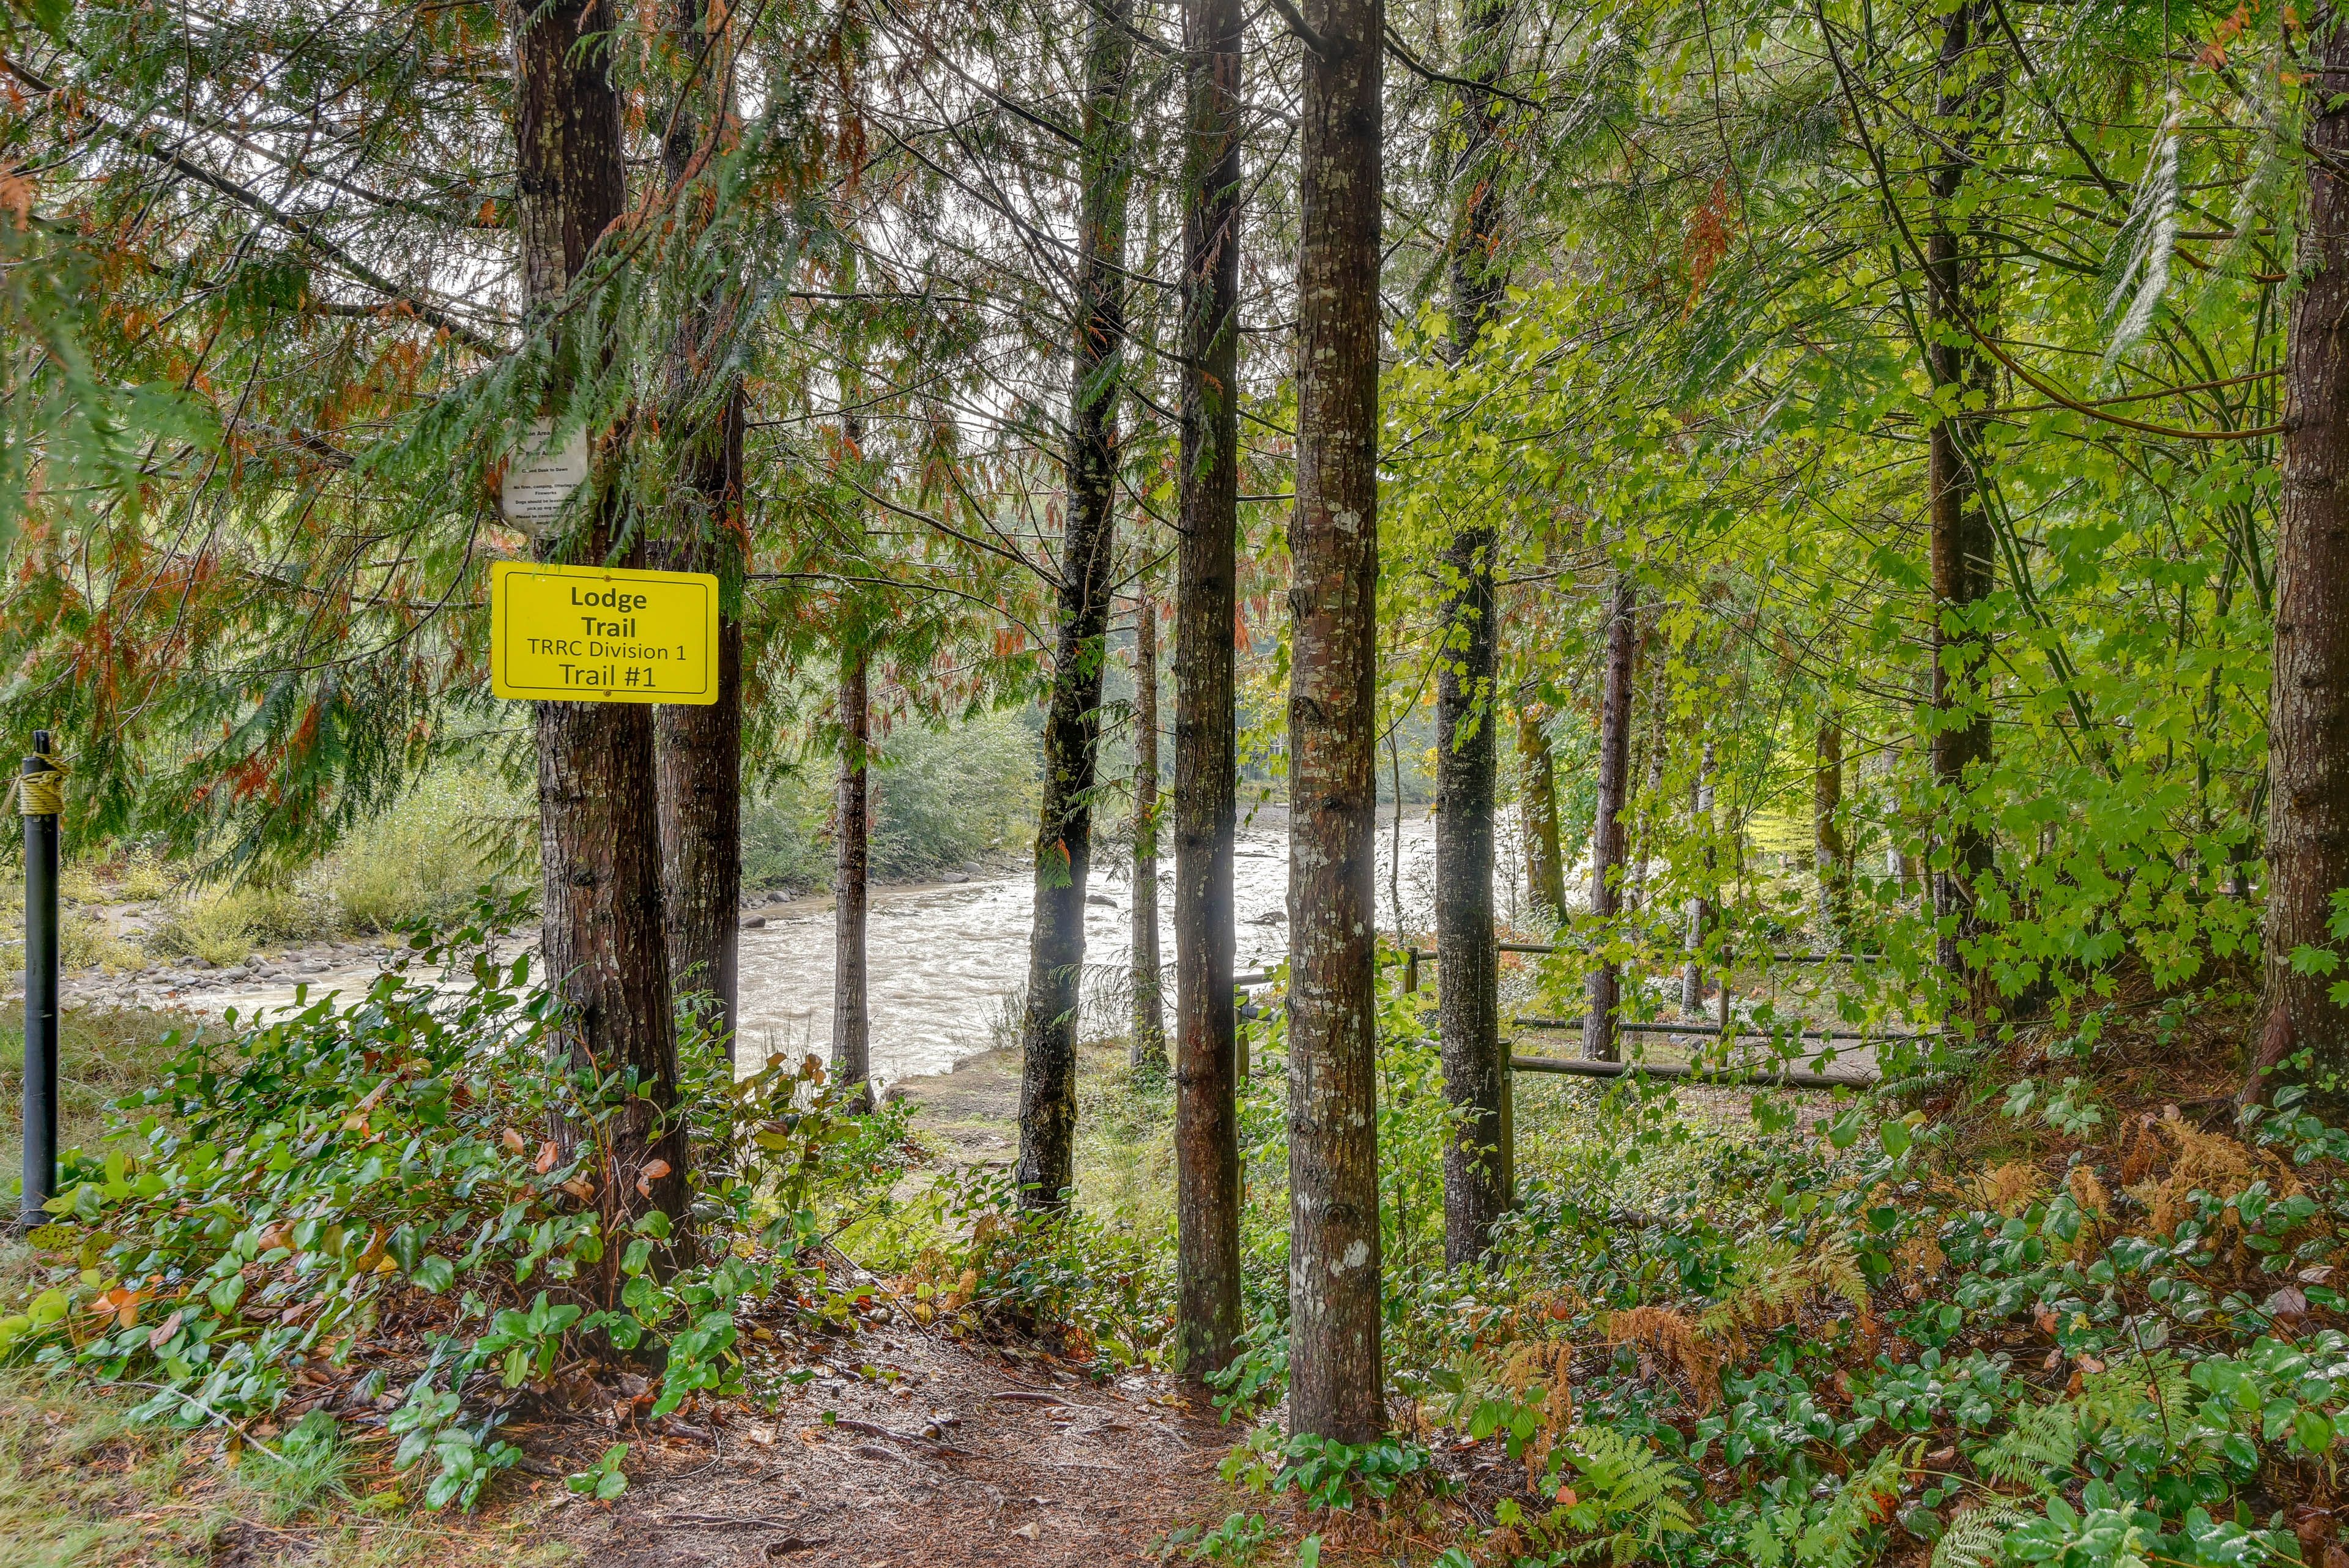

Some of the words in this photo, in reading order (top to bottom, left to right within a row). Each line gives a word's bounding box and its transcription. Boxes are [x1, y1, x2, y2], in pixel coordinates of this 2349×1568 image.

[571, 586, 647, 613] Lodge
[581, 616, 636, 638] Trail
[527, 638, 583, 656] TRRC
[590, 641, 668, 660] Division
[676, 645, 687, 661] 1
[558, 664, 615, 686] Trail
[624, 666, 656, 688] #1
